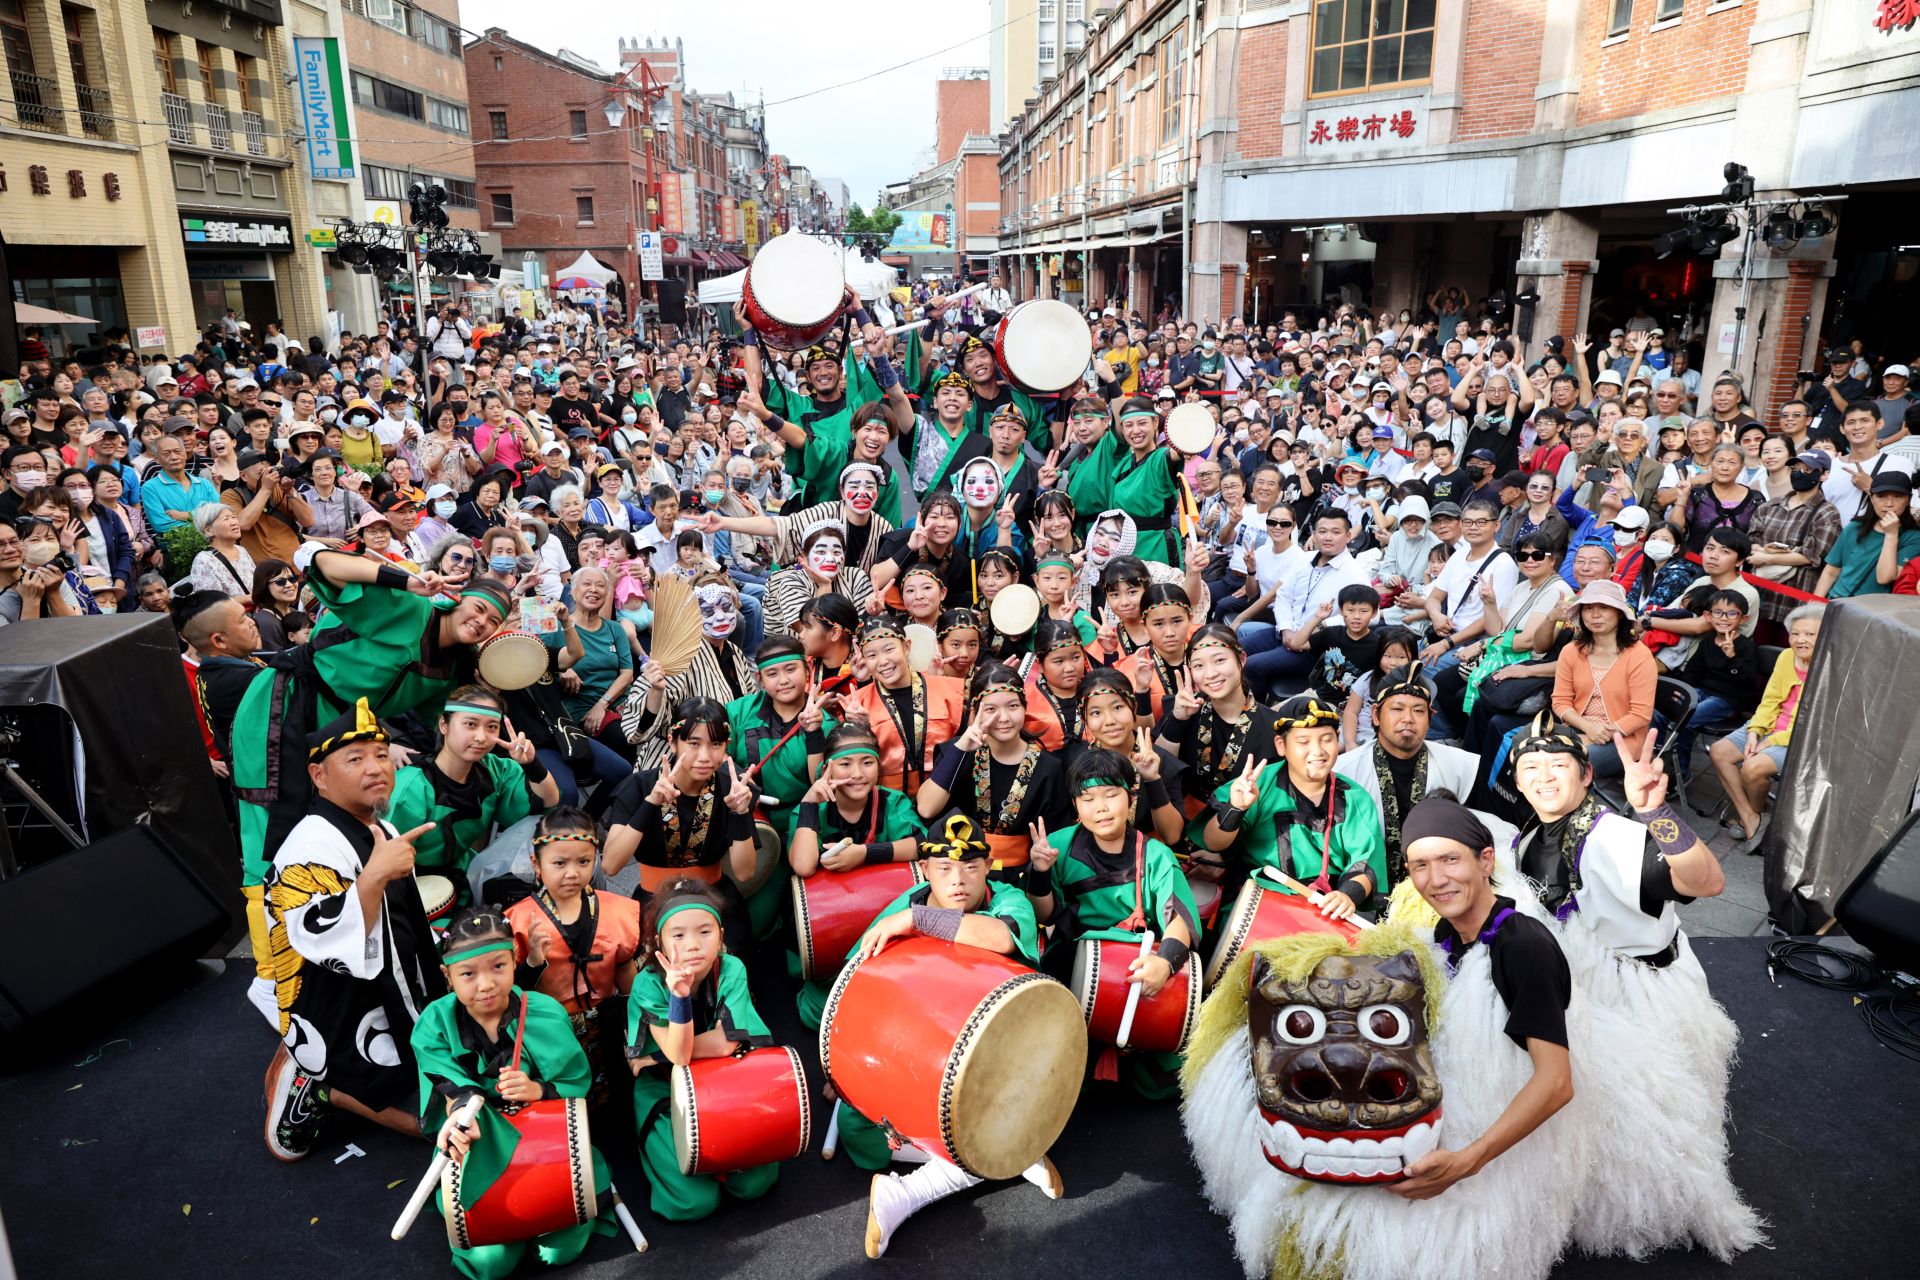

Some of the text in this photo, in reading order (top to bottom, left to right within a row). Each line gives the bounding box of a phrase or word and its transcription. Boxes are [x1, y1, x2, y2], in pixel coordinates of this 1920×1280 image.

[304, 50, 332, 156] FamilyMart
[1309, 110, 1417, 145] 永樂市場
[203, 221, 290, 246] 全家 FamilyMart
[190, 263, 244, 275] amilyMart
